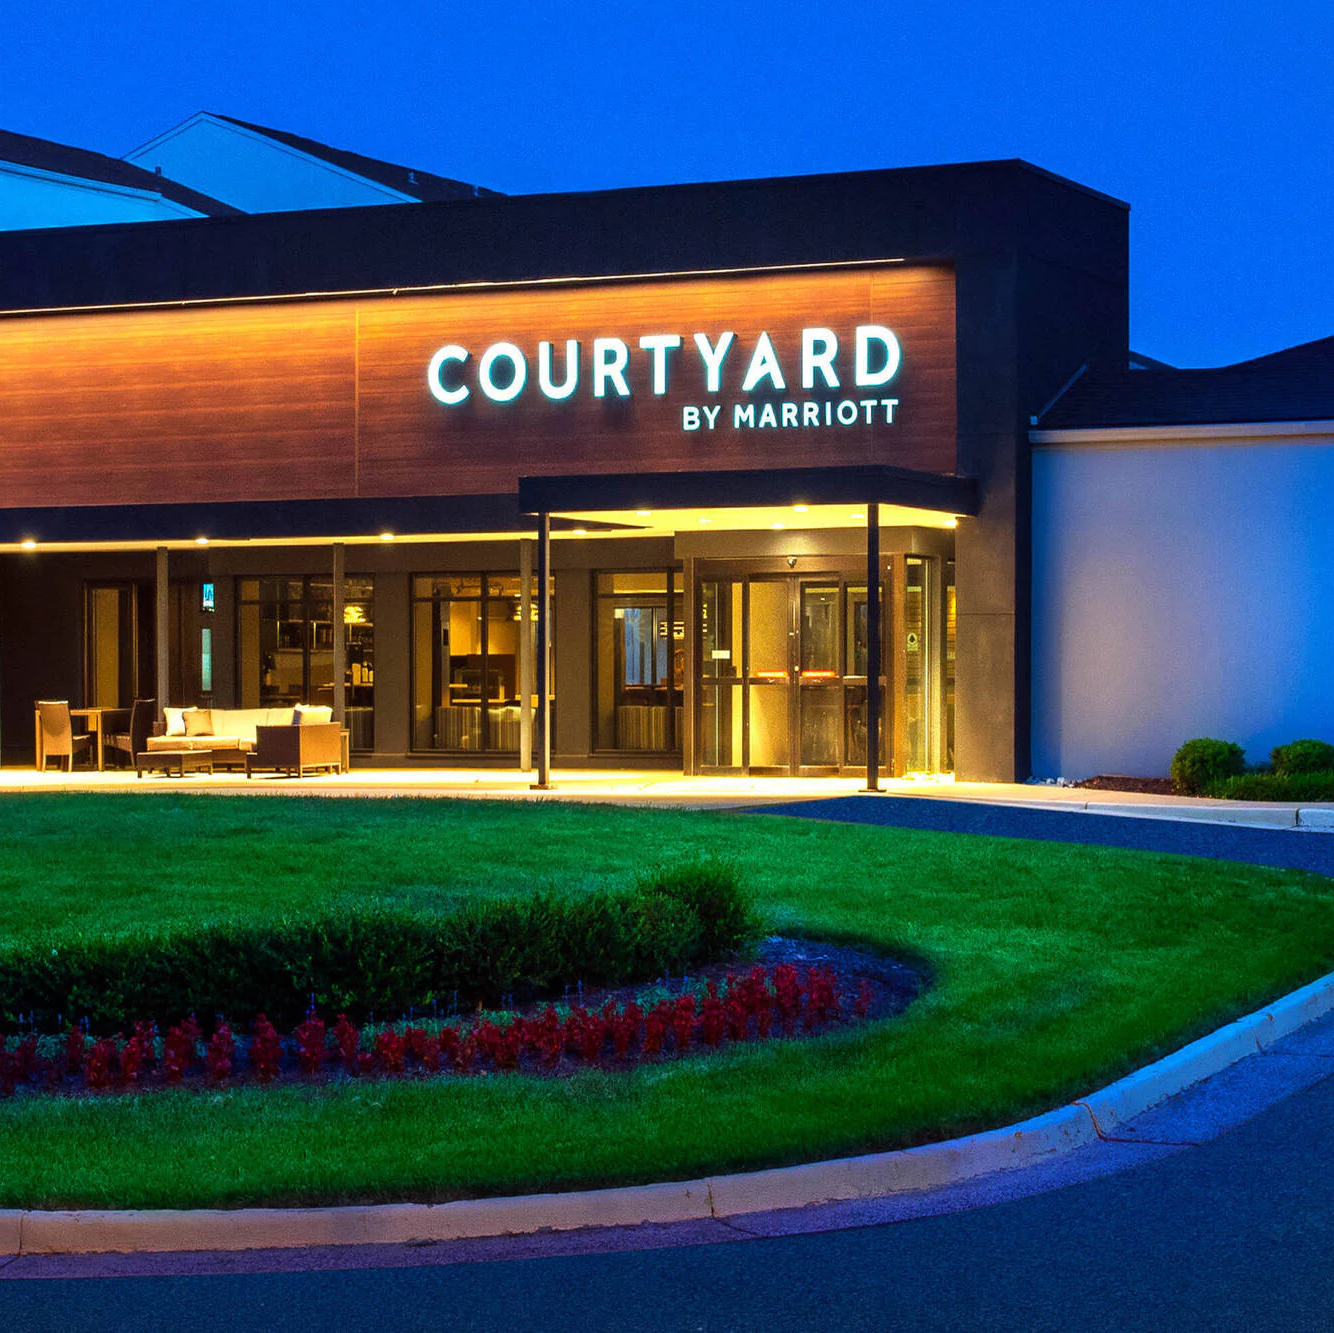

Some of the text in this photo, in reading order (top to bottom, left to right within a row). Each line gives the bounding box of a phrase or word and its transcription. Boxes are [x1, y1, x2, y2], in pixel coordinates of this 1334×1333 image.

[427, 324, 900, 404] COURTYARD
[682, 399, 899, 431] BY MARRIOTT
